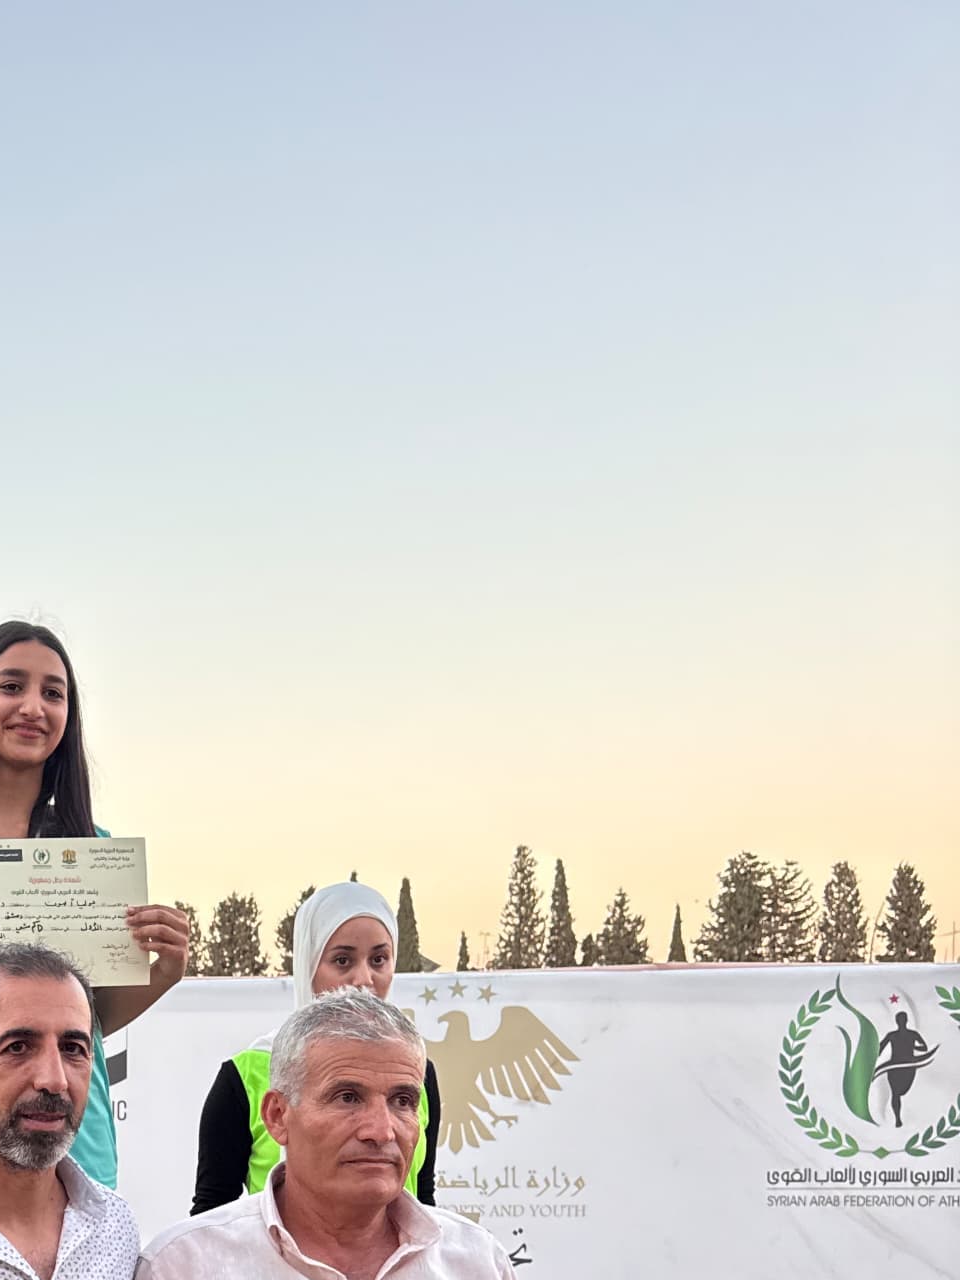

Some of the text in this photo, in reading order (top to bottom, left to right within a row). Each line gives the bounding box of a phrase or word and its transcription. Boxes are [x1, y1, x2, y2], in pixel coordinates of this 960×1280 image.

[437, 1165, 585, 1197] وزارة الرياضة
[858, 1167, 907, 1186] السوري
[910, 1167, 954, 1186] العربي
[767, 1195, 807, 1207] SYRIAN
[810, 1195, 841, 1207] ARAB
[843, 1195, 914, 1207] FEDERATION
[917, 1195, 935, 1207] OF
[490, 1204, 525, 1217] AND
[529, 1204, 586, 1218] YOUTH
